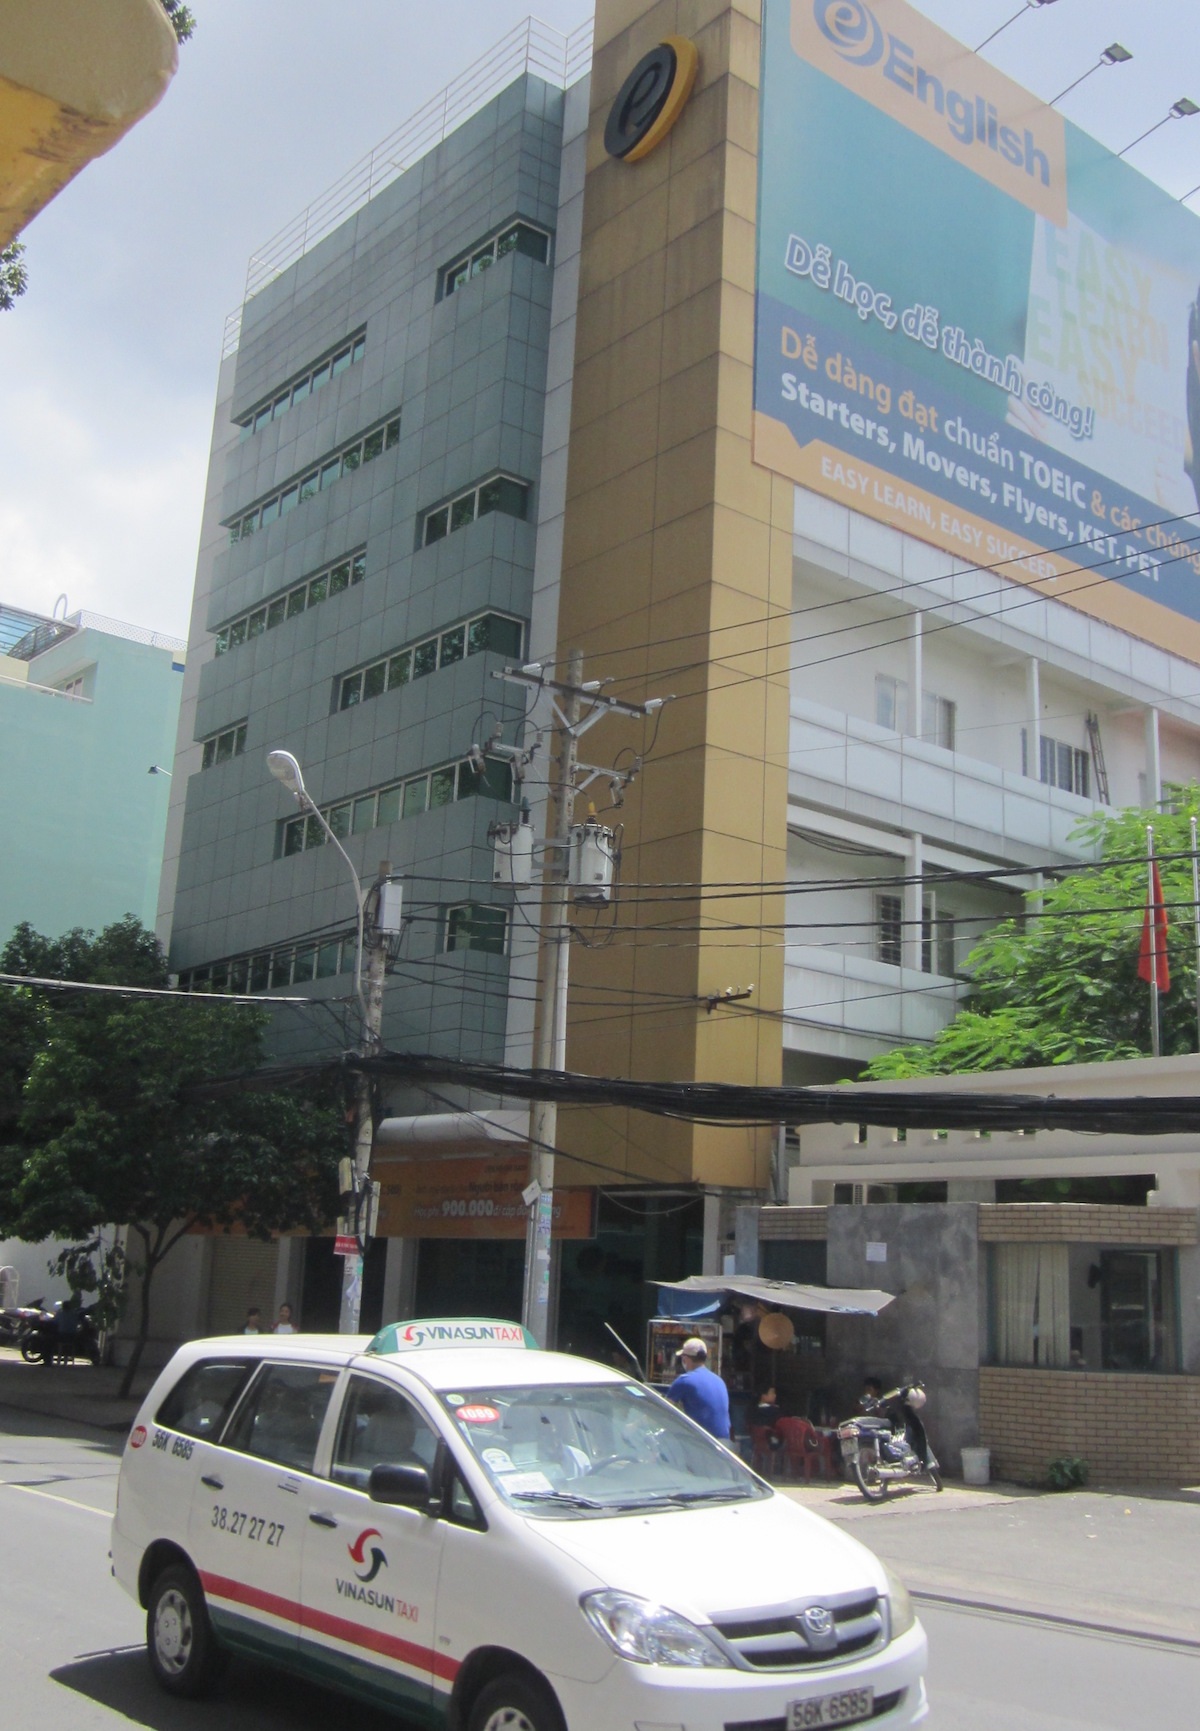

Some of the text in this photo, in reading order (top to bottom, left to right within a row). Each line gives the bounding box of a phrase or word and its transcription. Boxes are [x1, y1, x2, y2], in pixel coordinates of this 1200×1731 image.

[883, 32, 1051, 188] English
[784, 234, 1094, 439] Dễ học, dễ thành công!
[780, 371, 1163, 583] Starters, Movers, Flyers, KET, PET
[781, 326, 818, 371] Dễ
[825, 352, 892, 414] dàng
[898, 389, 939, 434] đạt
[944, 416, 1015, 472] chuẩn
[1018, 449, 1087, 510] TOEIC
[1090, 489, 1107, 520] &
[1110, 506, 1143, 539] các
[821, 454, 1059, 583] EASY LEARN, EASY SUCCEED
[459, 1407, 495, 1420] 1089
[211, 1505, 285, 1548] 38.27 27 27
